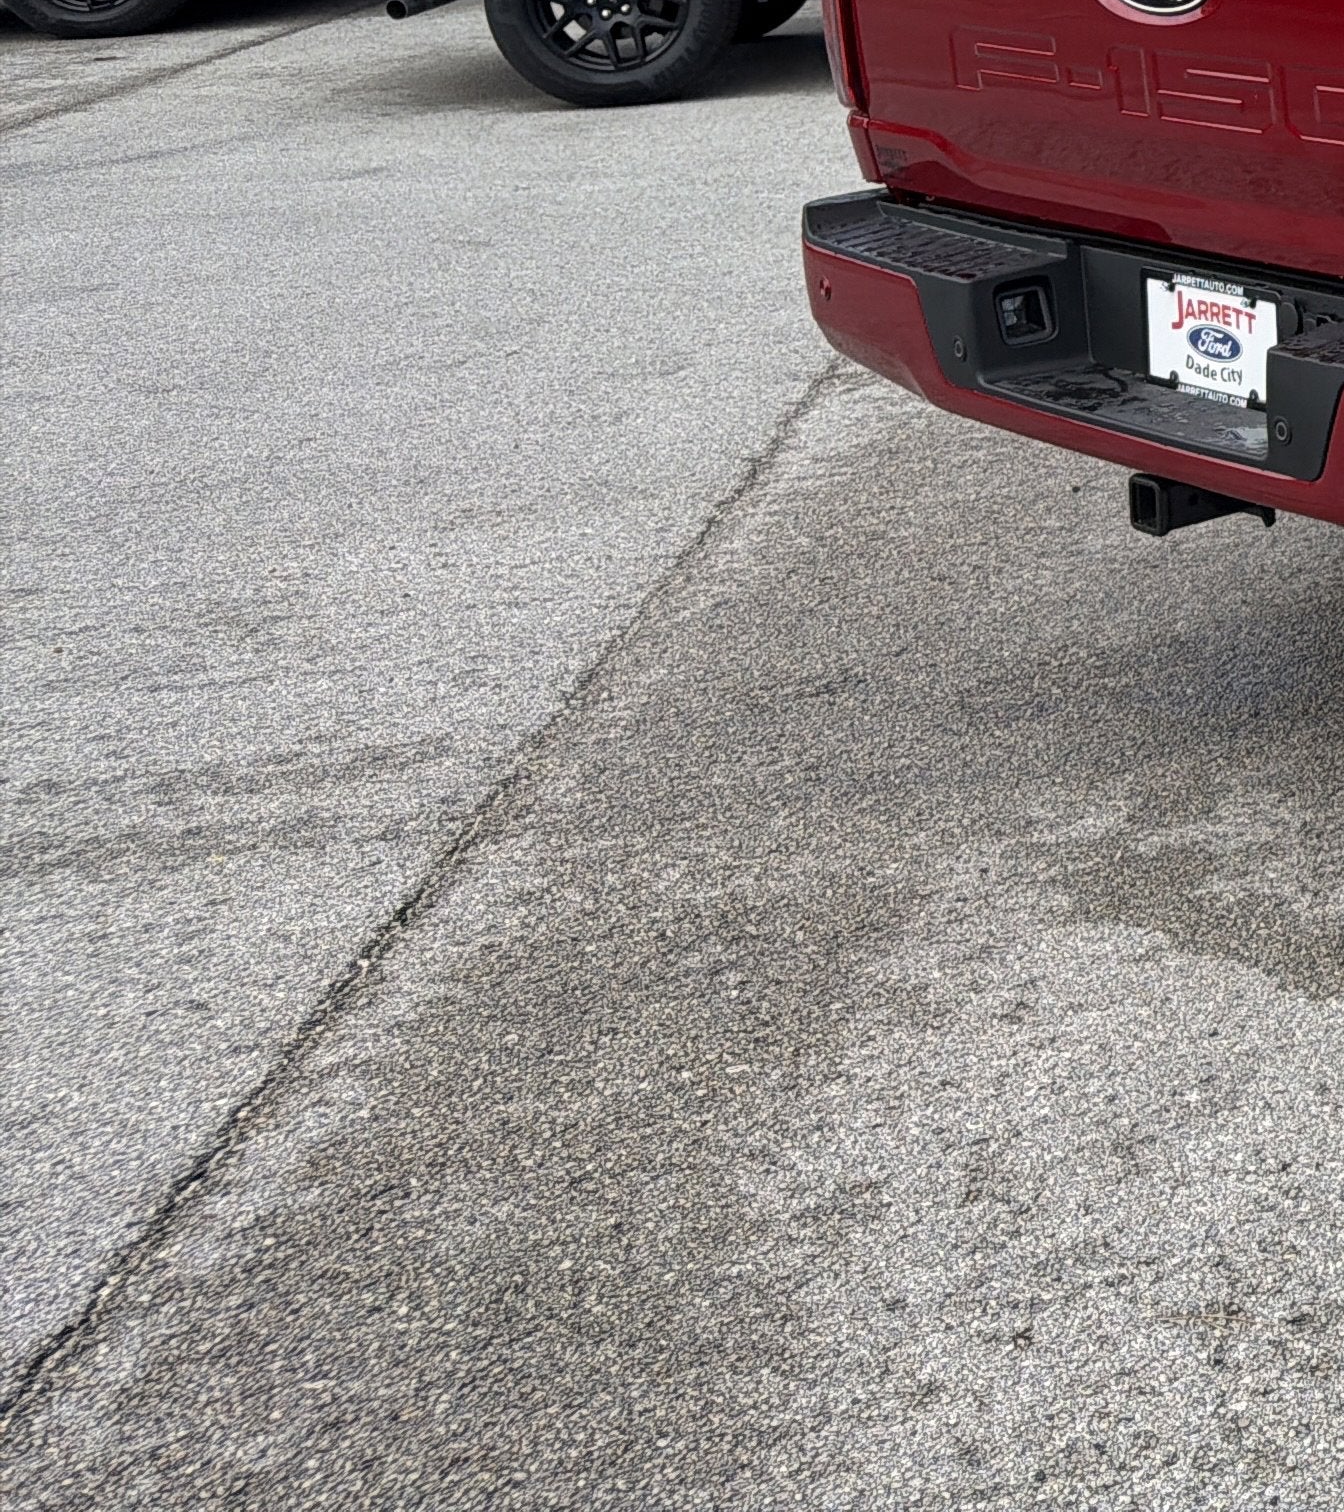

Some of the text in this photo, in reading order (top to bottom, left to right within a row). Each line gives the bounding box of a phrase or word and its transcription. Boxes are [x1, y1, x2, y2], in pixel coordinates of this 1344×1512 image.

[1171, 290, 1257, 335] JARRETT
[1197, 328, 1233, 358] Ford
[1185, 354, 1244, 386] Dade City
